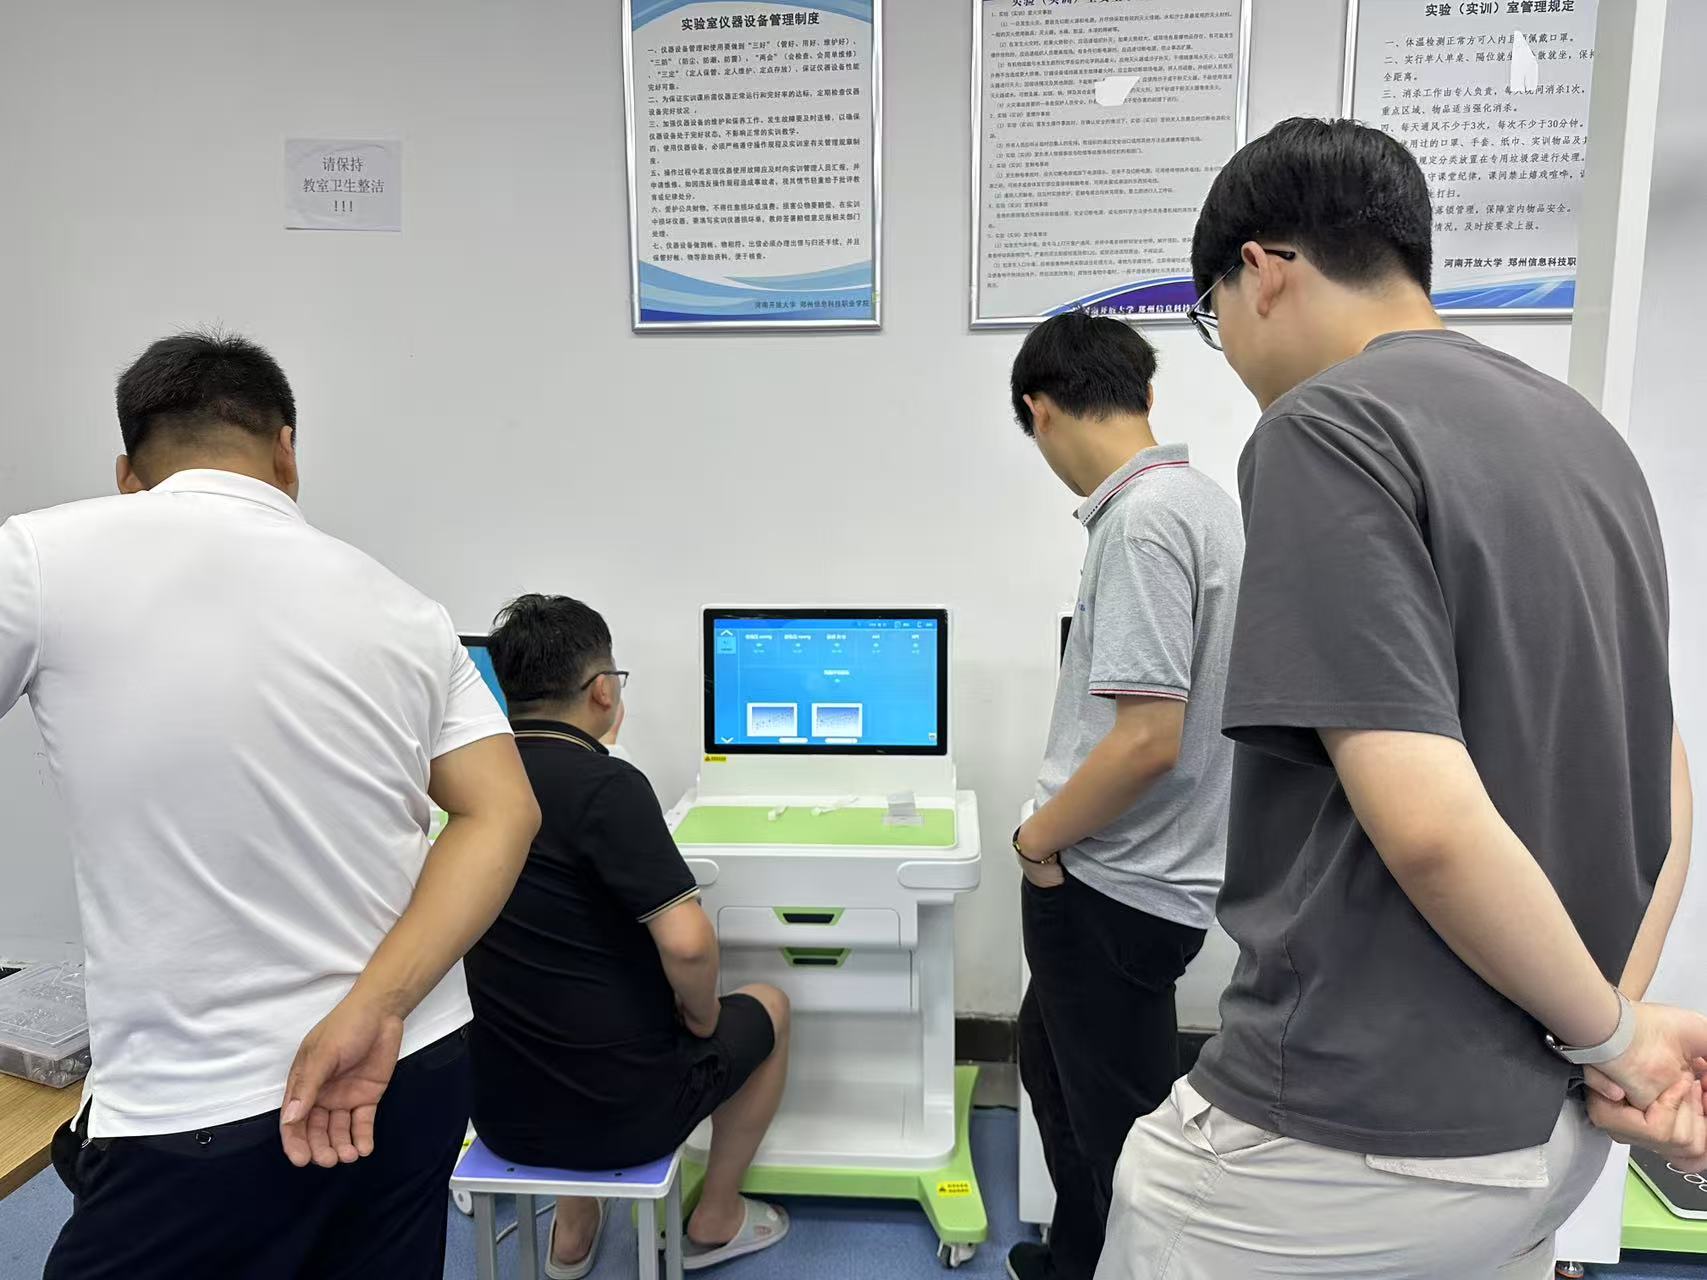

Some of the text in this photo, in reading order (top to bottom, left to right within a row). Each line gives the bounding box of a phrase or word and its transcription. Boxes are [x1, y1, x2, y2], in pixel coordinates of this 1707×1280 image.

[1425, 0, 1575, 16] 实验（实训）室管理规定
[681, 12, 820, 31] 实验室仪器设备管理制度
[1384, 72, 1418, 82] 全距离。
[322, 157, 364, 172] 请保持
[303, 177, 385, 193] 教室卫生整洁
[1444, 258, 1503, 268] 河南开放大学
